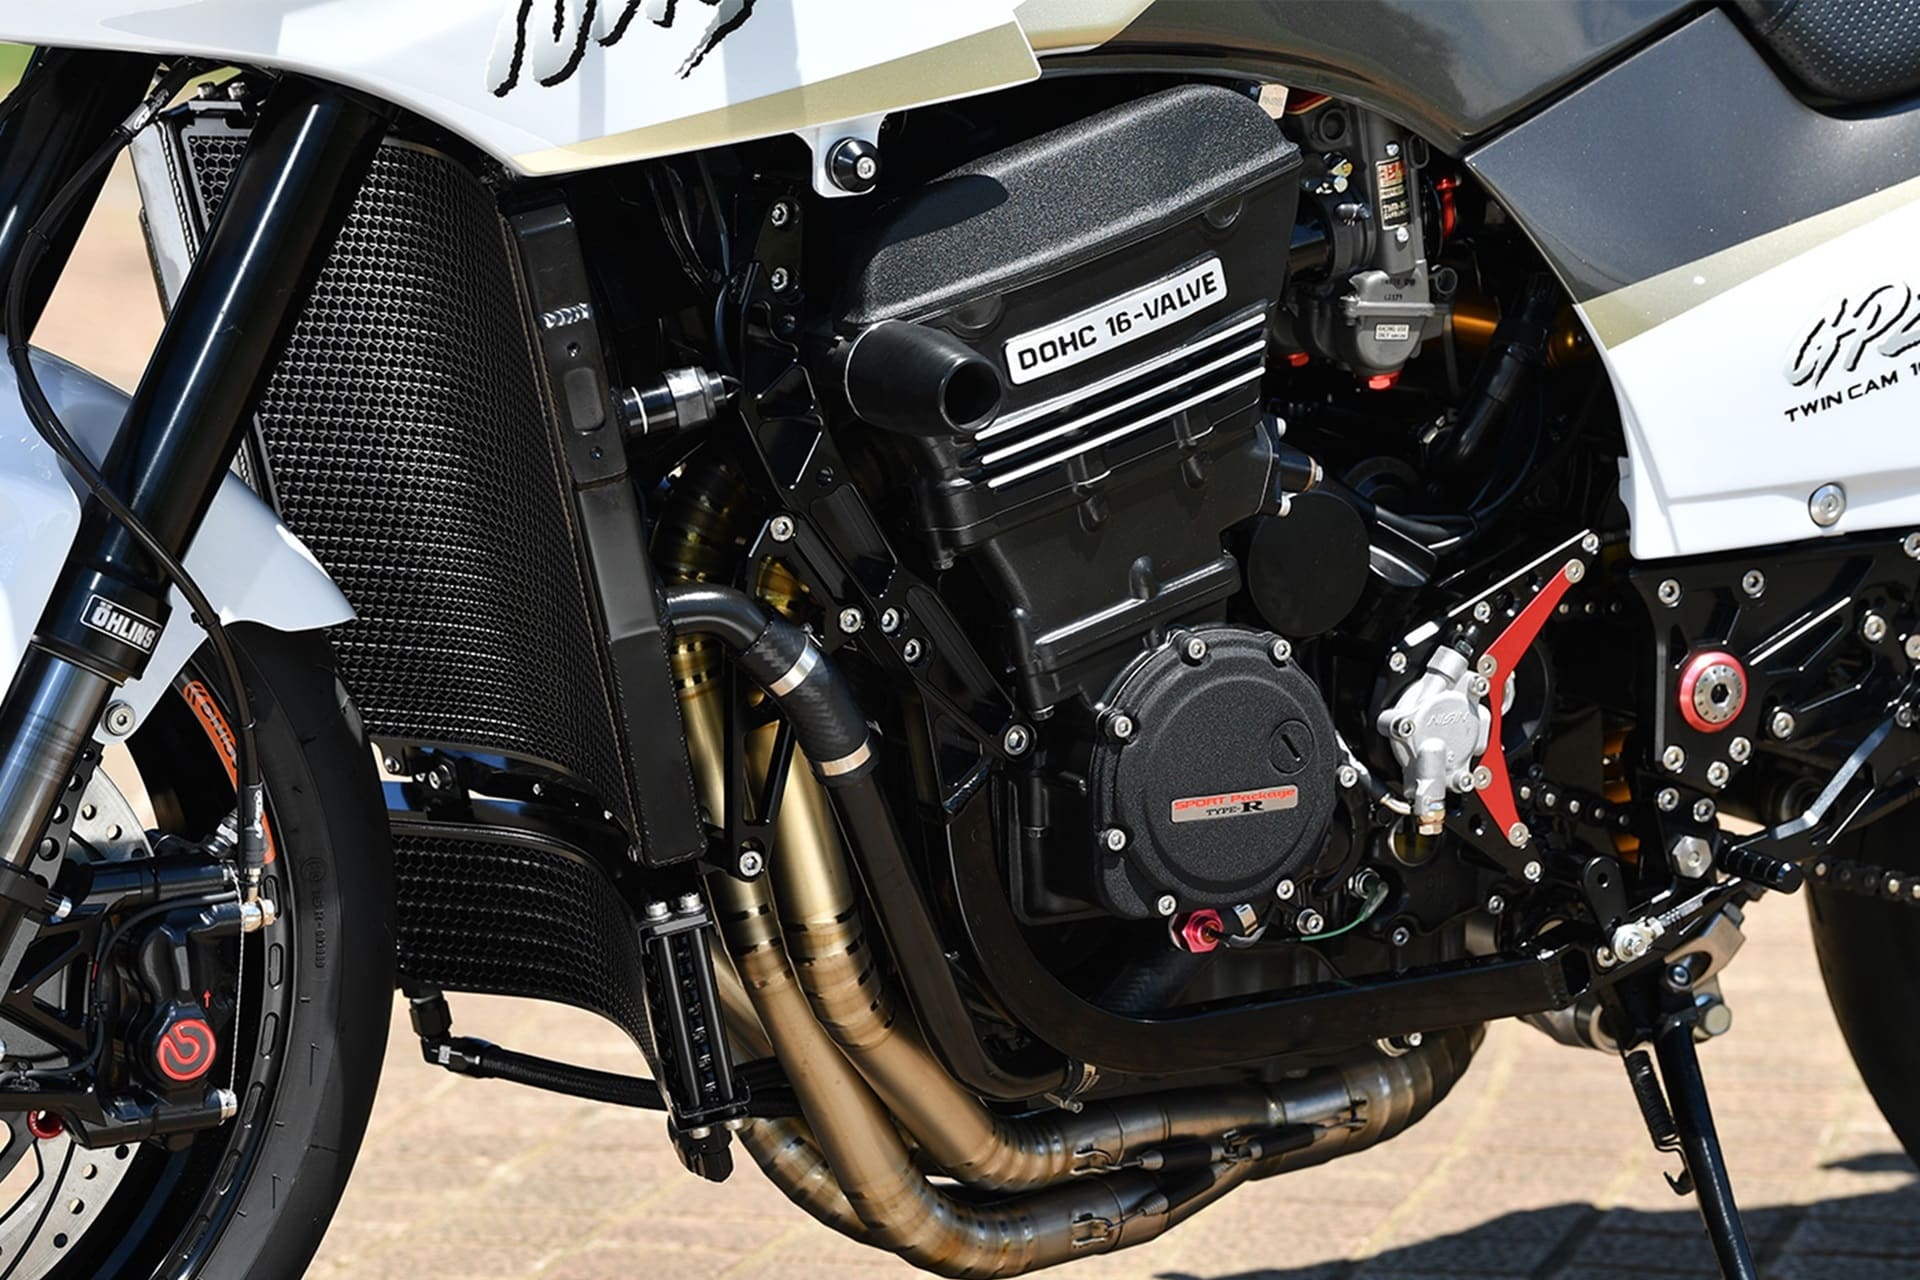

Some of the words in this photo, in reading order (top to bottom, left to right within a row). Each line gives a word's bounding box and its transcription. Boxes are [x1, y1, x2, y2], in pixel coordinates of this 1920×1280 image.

[1017, 325, 1098, 371] DOHC
[1105, 271, 1218, 337] 16-VALVE
[1784, 391, 1843, 422] TWIN
[1847, 370, 1899, 400] CAM
[90, 601, 156, 649] ÖHLINS
[1174, 795, 1226, 811] SPORT
[1229, 788, 1296, 804] Package
[1206, 800, 1265, 816] TYPE-R
